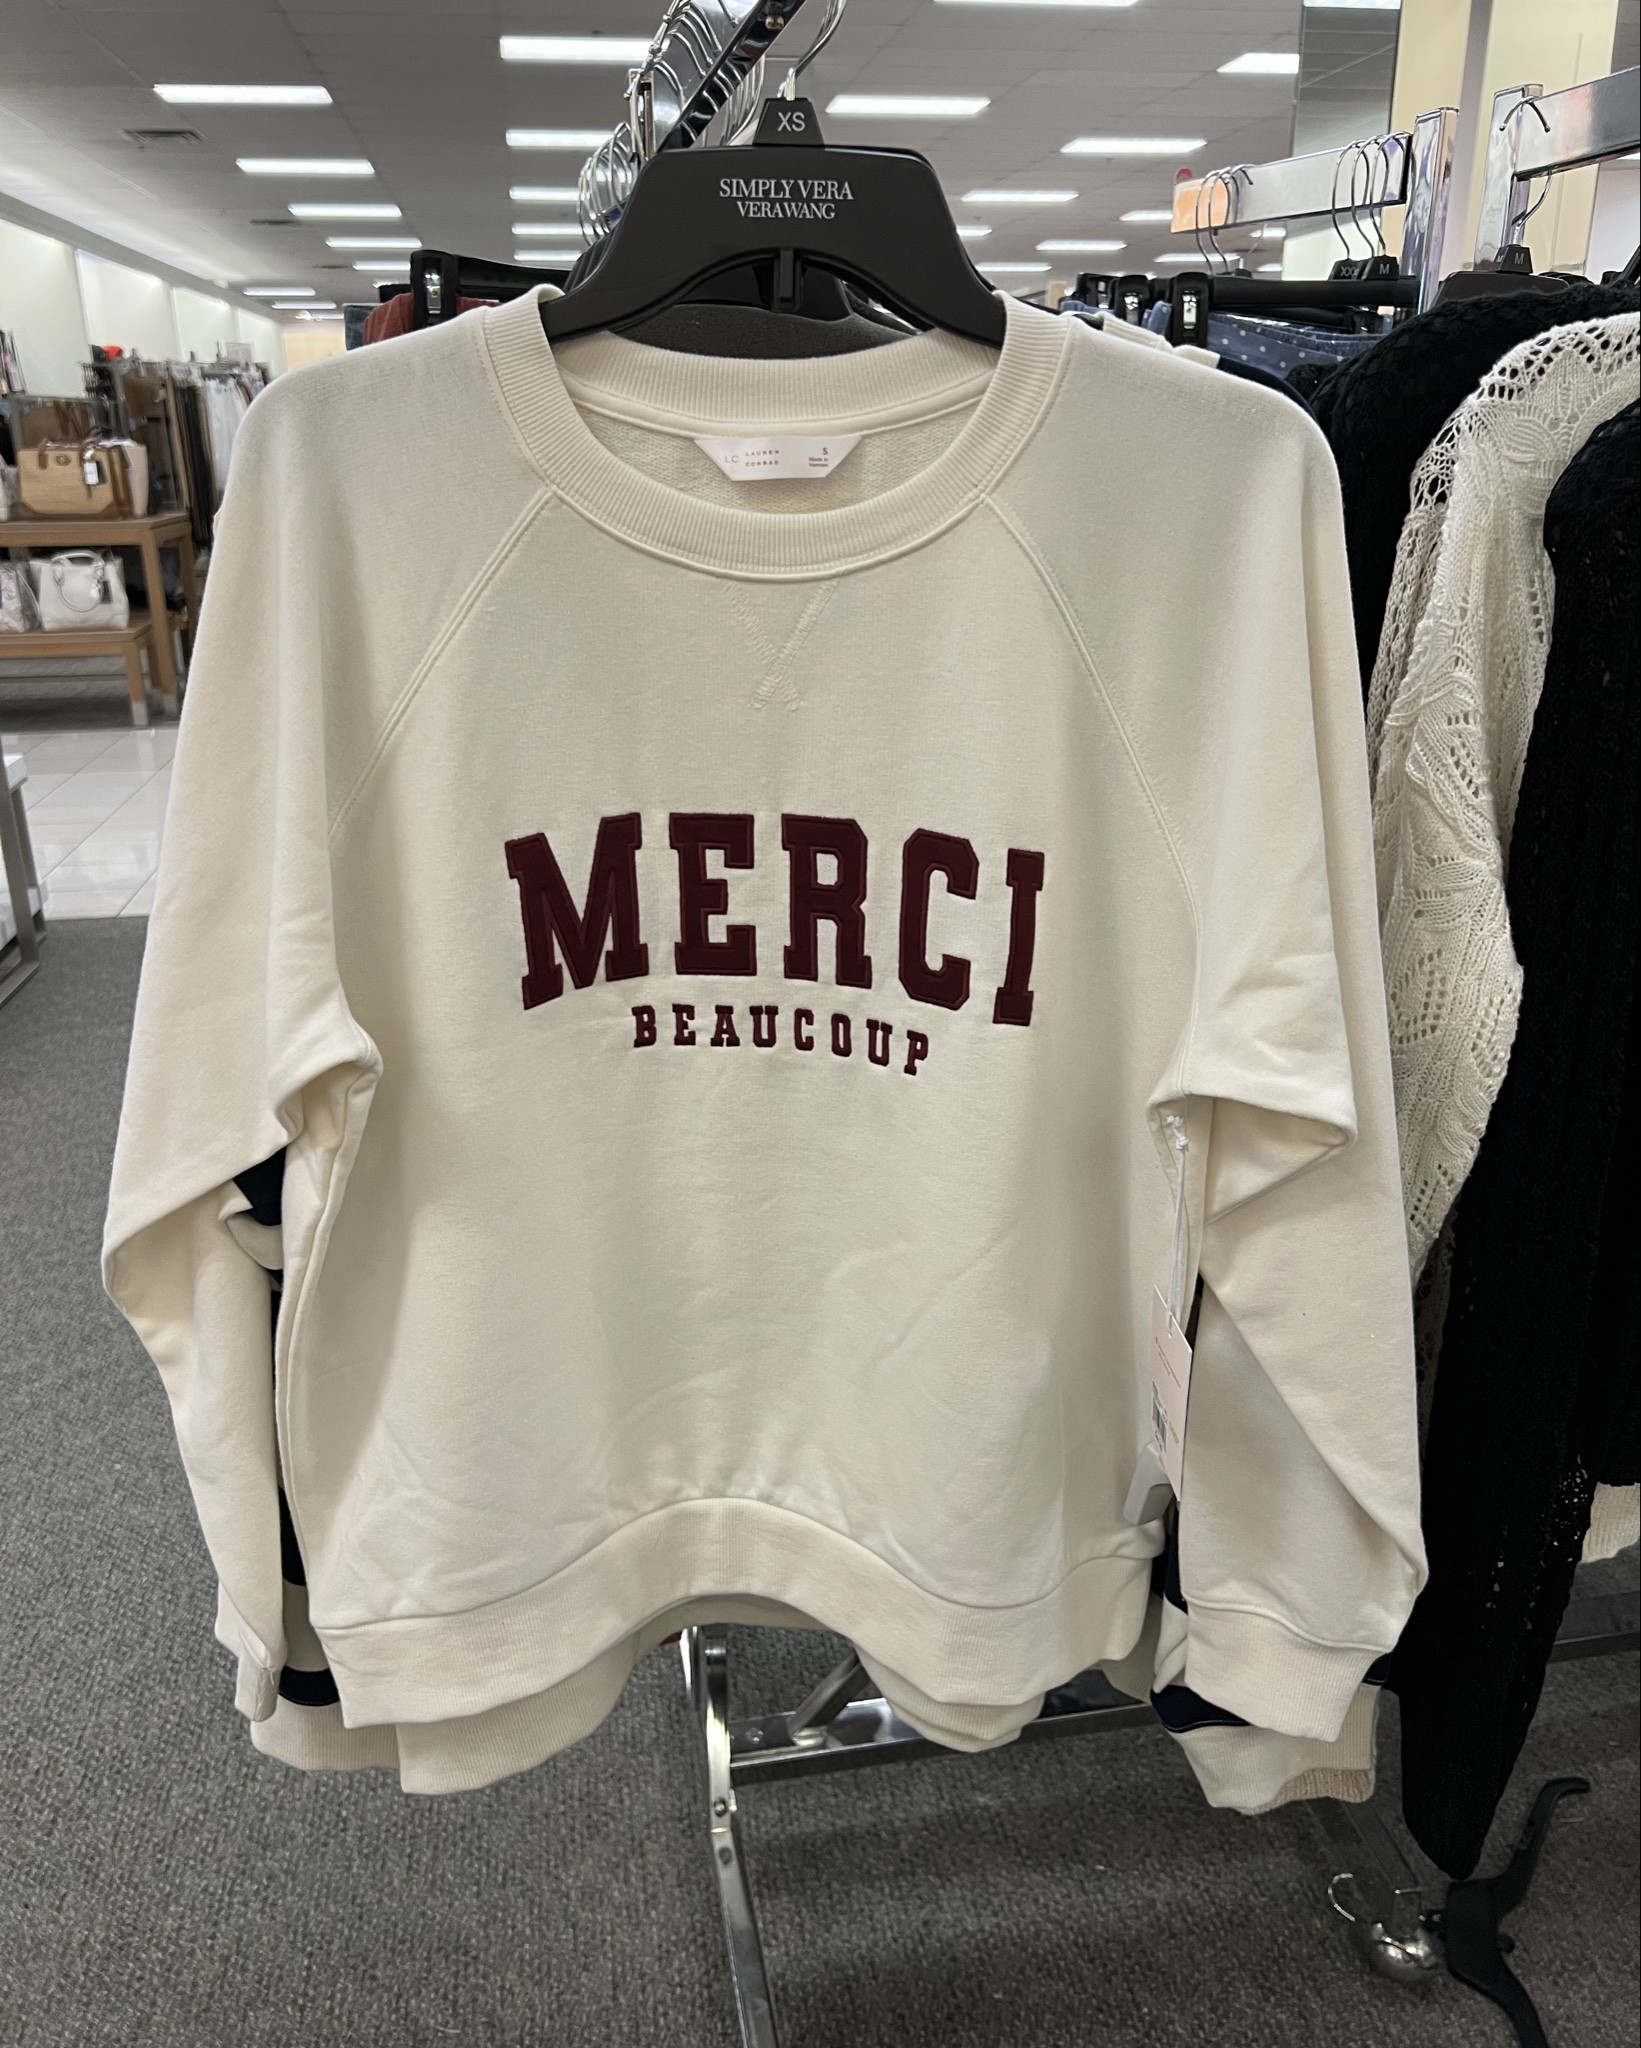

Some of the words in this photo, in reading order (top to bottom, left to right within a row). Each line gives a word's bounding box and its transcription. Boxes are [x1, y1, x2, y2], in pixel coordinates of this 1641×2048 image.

[777, 111, 806, 132] XS
[719, 178, 794, 199] SIMPLY
[797, 180, 854, 200] VERA
[736, 201, 784, 218] VERA
[783, 202, 836, 220] WANG
[1515, 252, 1525, 265] M
[1379, 263, 1390, 275] M
[724, 455, 739, 464] LC
[505, 812, 1045, 1027] MERCI
[631, 1003, 929, 1076] BEAUCOUP
